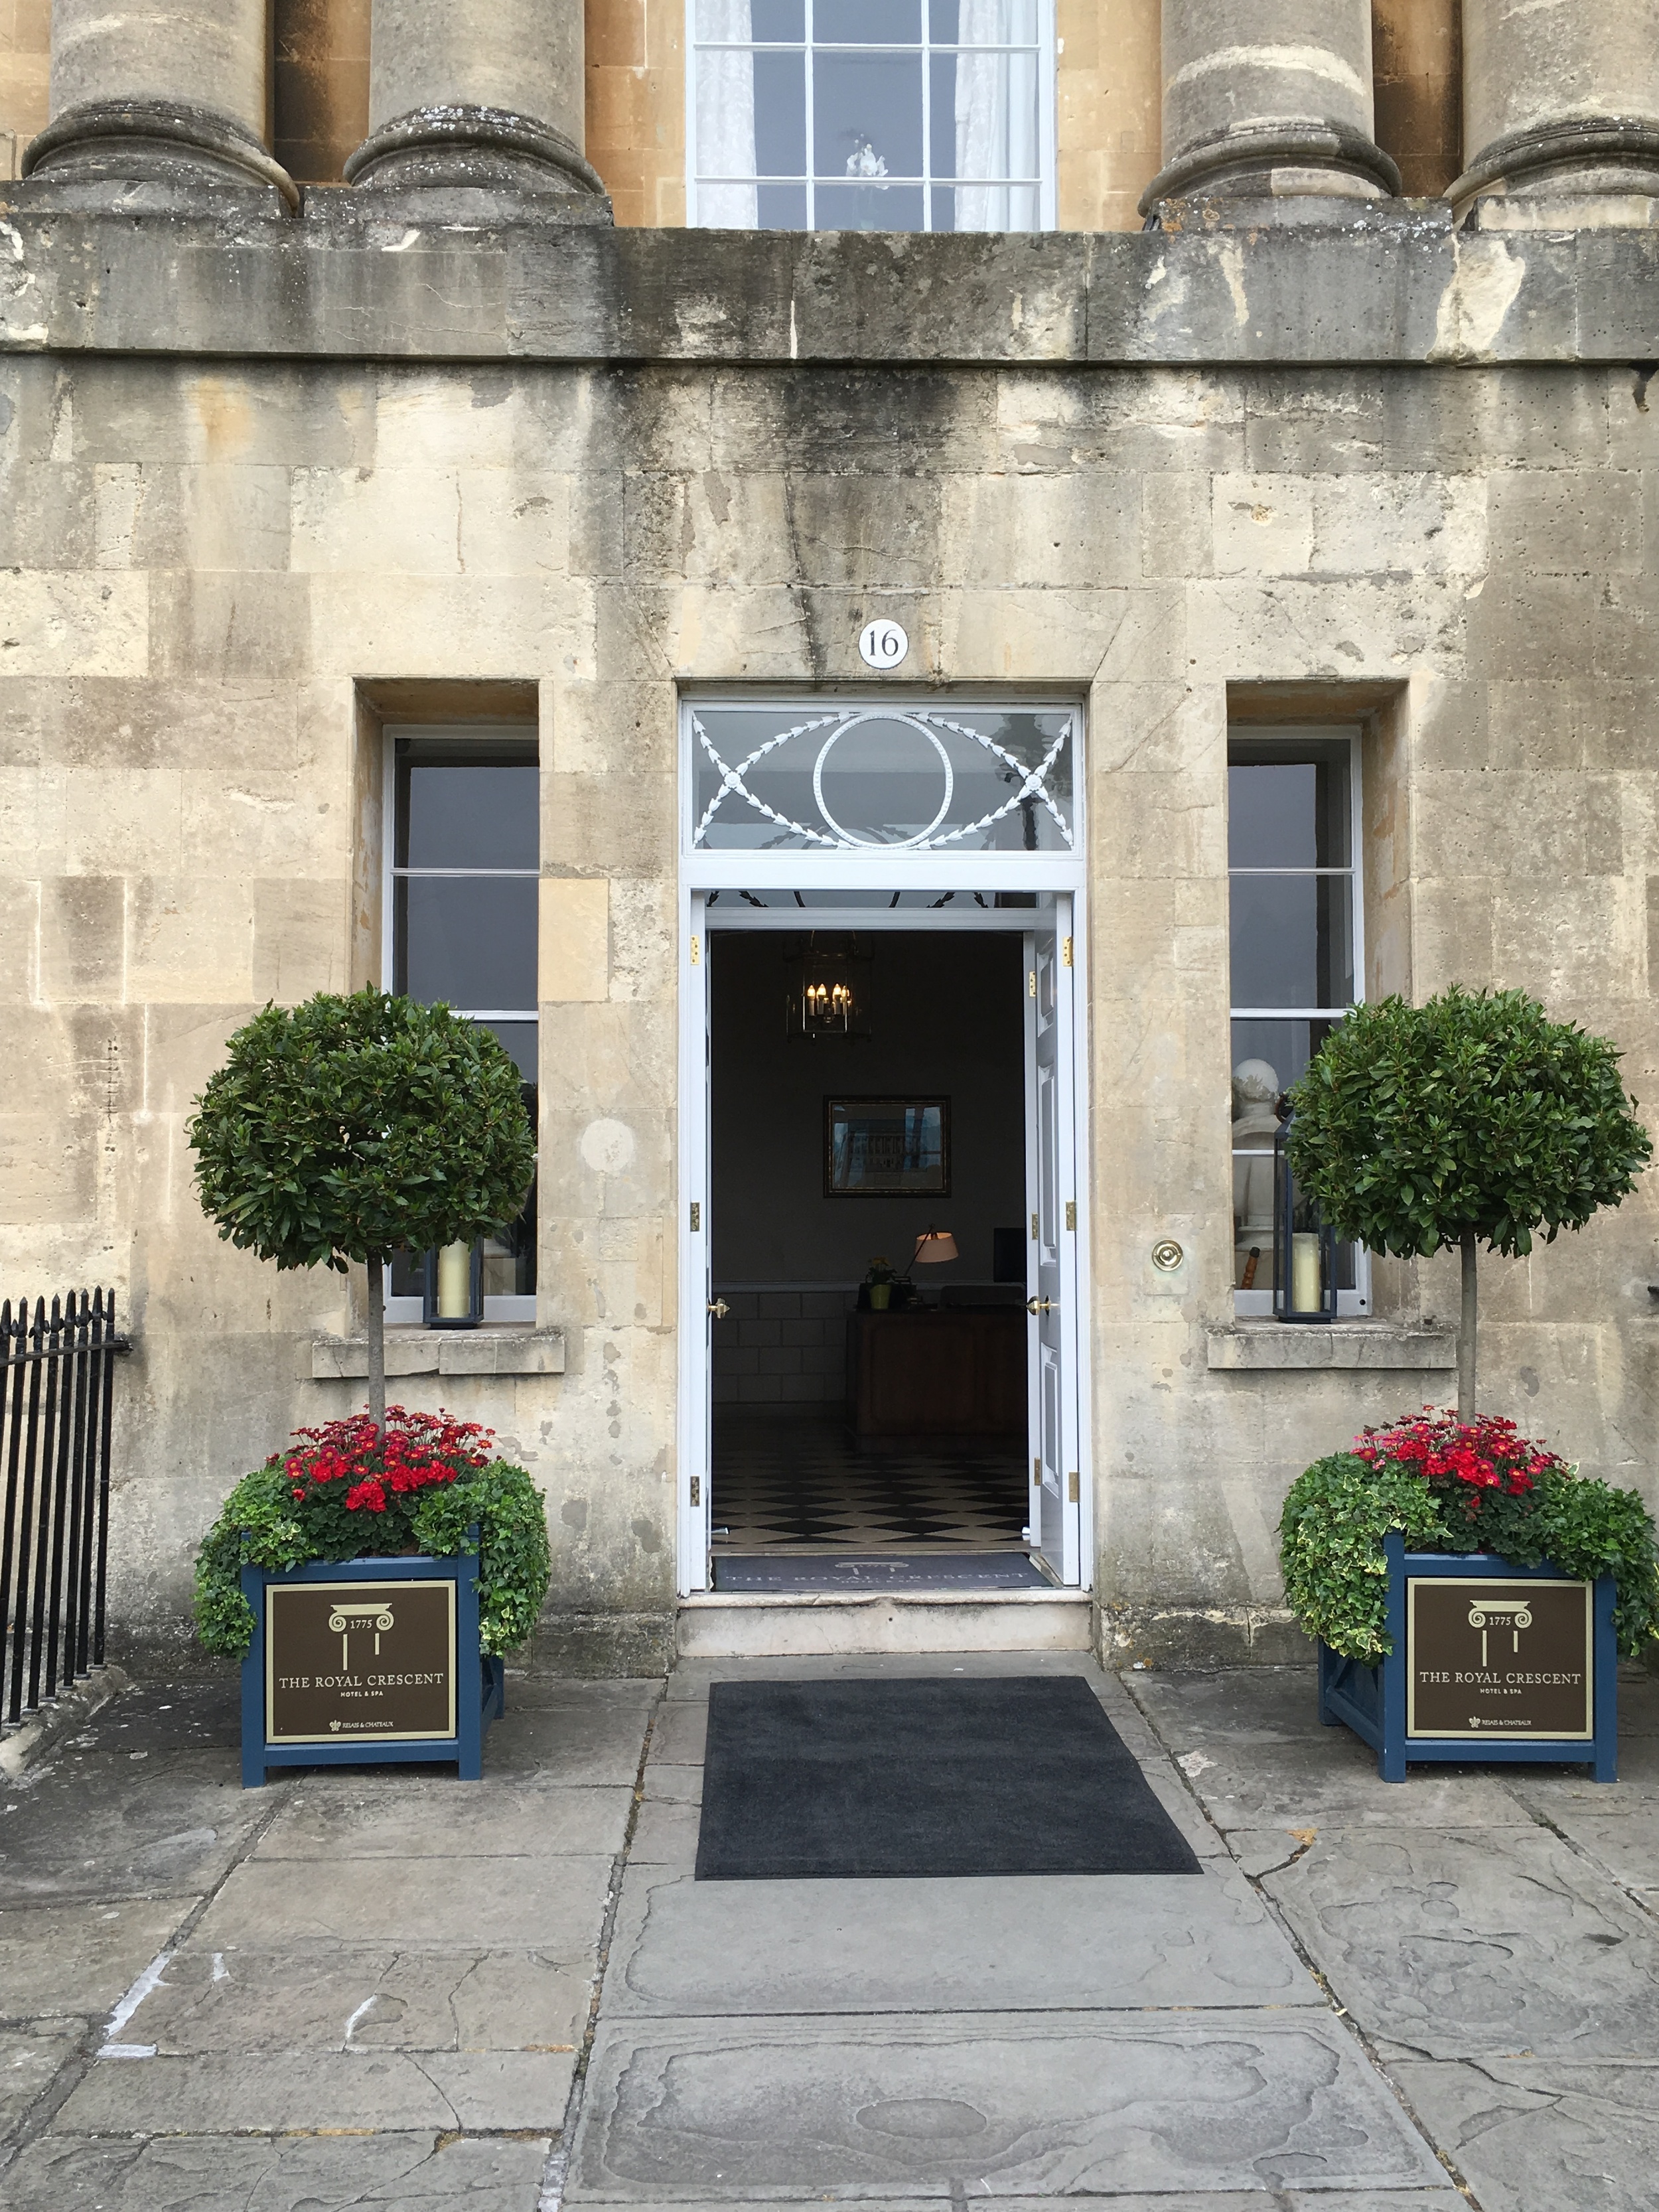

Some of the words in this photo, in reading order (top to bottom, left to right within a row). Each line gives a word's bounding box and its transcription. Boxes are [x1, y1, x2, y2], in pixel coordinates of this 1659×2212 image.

[869, 628, 899, 656] 16
[350, 1619, 372, 1629] 1775
[1489, 1617, 1511, 1626] 1775
[279, 1676, 310, 1688] THE
[315, 1675, 362, 1688] ROYAL
[367, 1672, 444, 1686] CRESCENT
[1419, 1671, 1450, 1683] THE
[1455, 1672, 1501, 1684] ROYAL
[1506, 1672, 1581, 1684] CRESCENT
